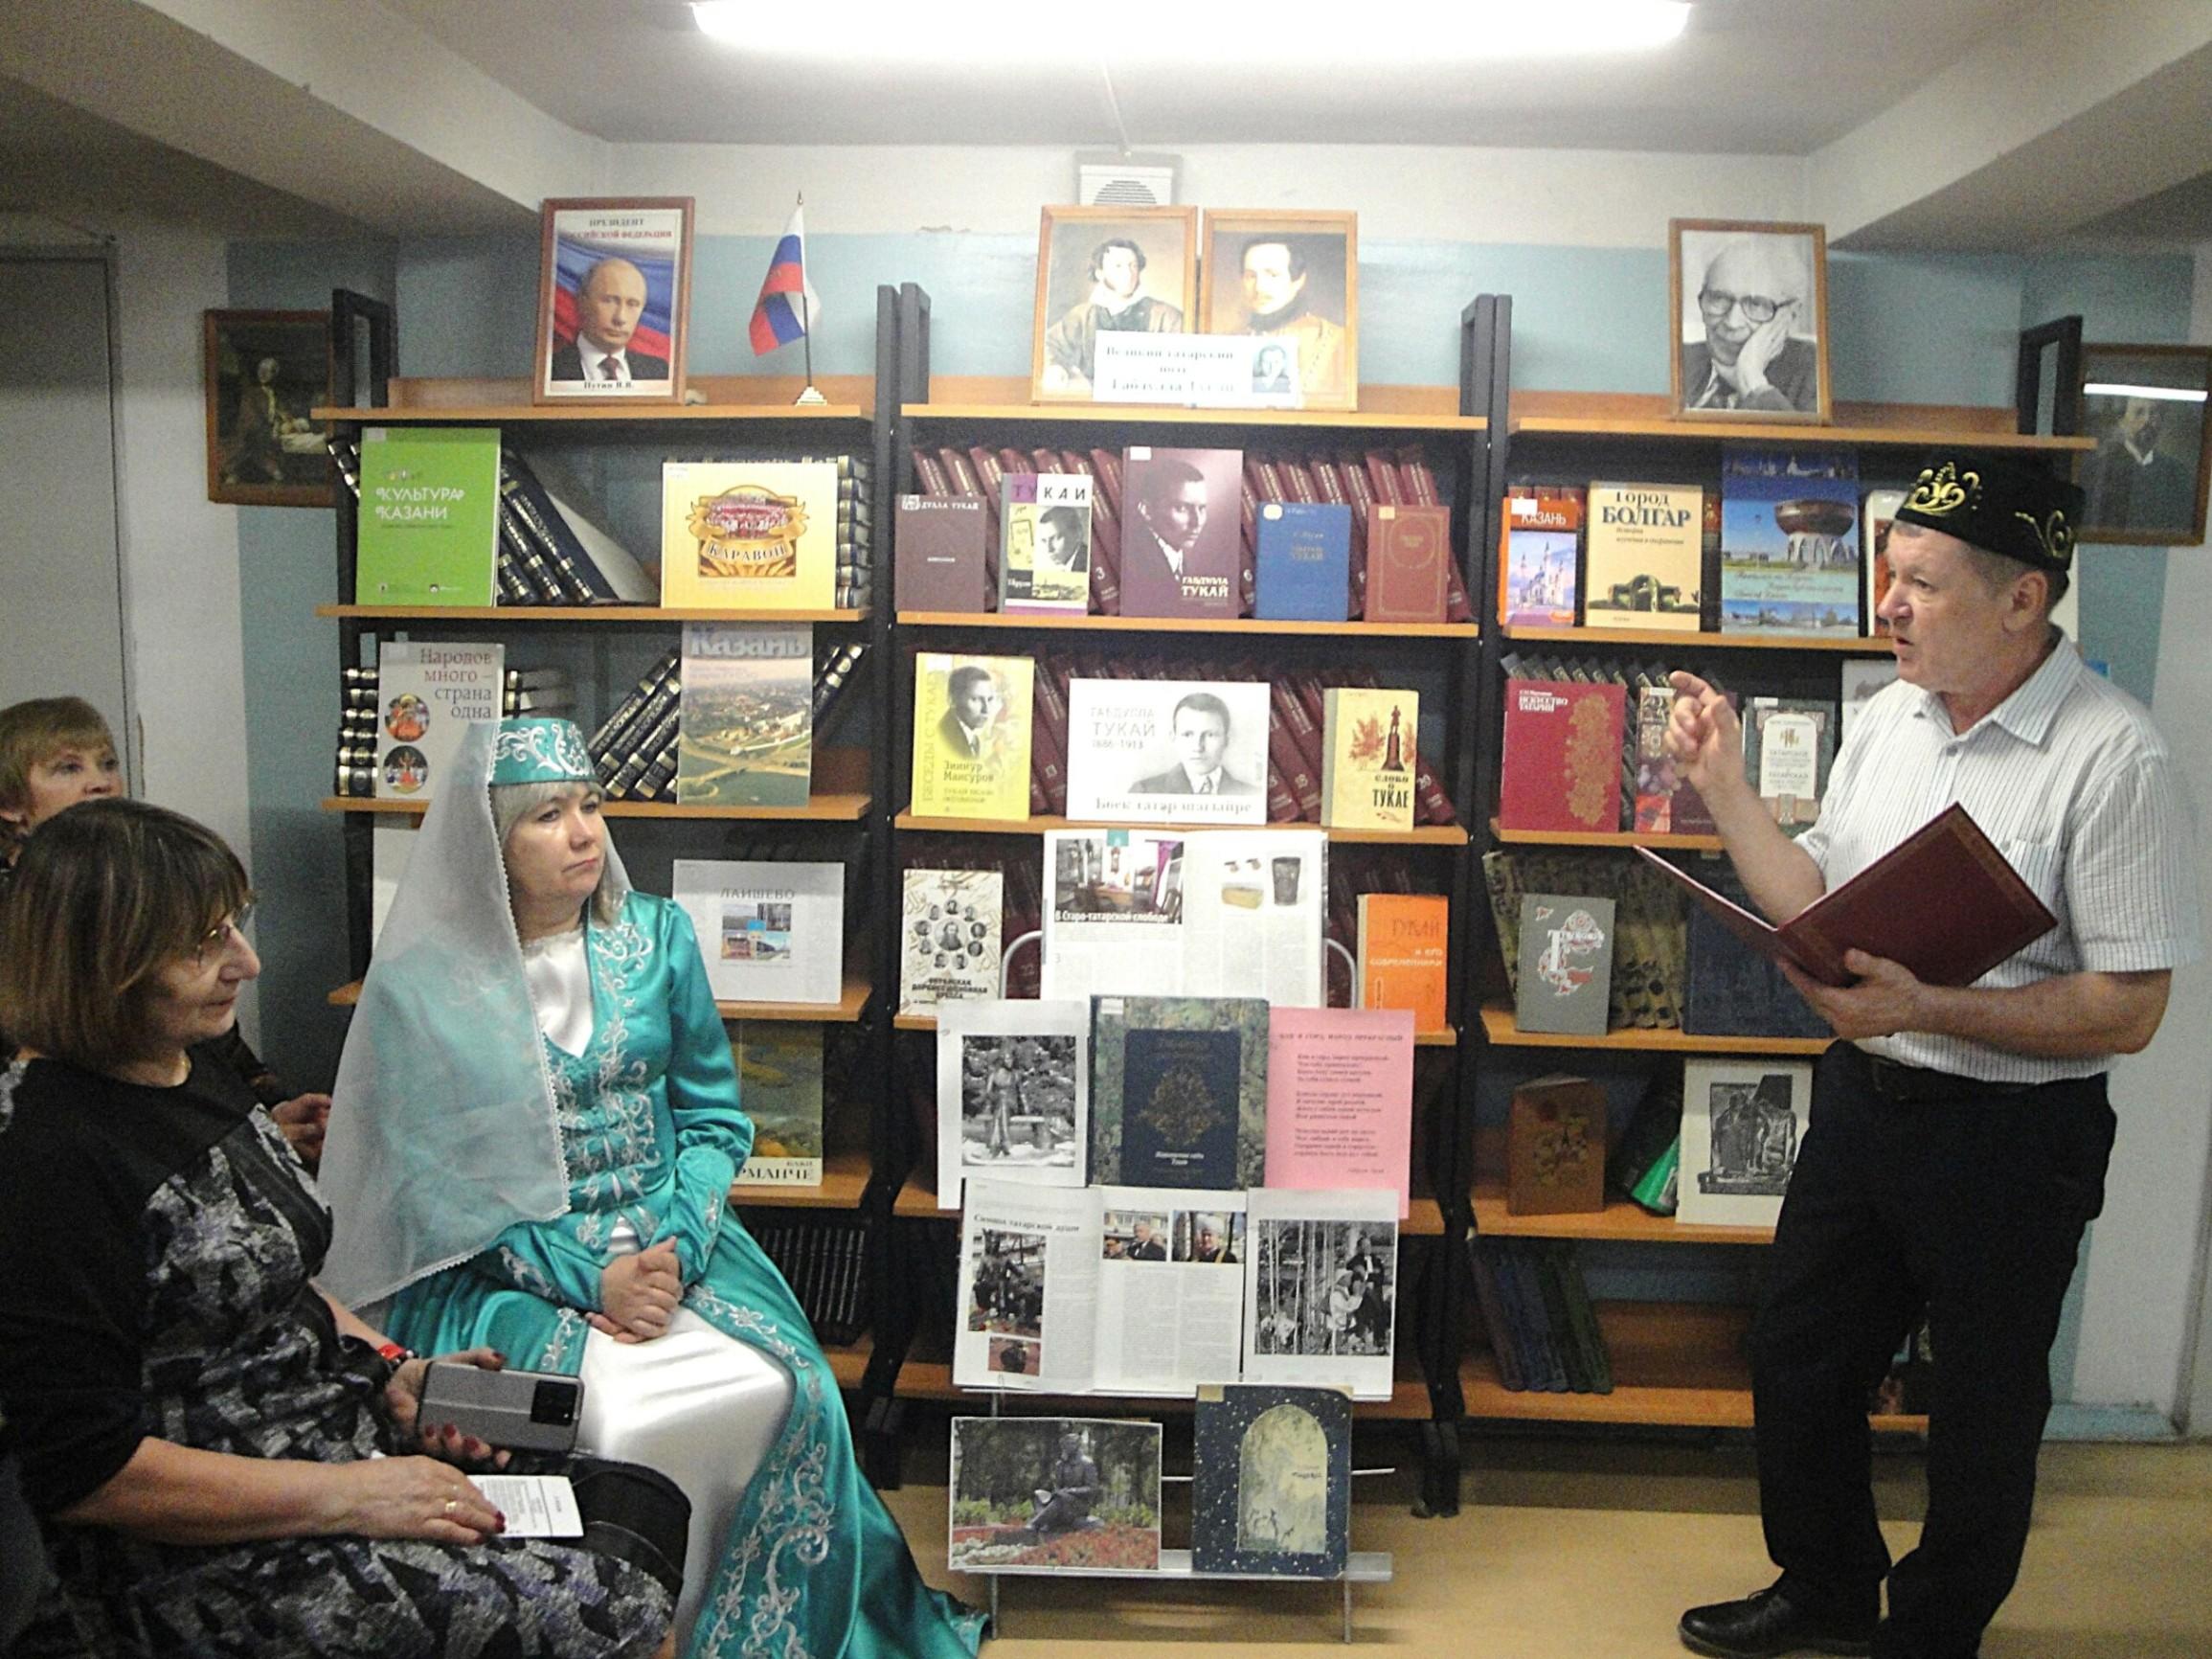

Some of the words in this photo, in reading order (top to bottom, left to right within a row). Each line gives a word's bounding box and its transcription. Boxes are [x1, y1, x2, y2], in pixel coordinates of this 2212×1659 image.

[1521, 511, 1567, 526] КАЗАНЬ
[1602, 506, 1692, 528] БОЛГАР
[1181, 585, 1230, 598] ТУКАЙ
[420, 648, 492, 668] Народов
[424, 670, 478, 682] много
[435, 689, 491, 704] страна
[451, 706, 491, 718] одна
[1372, 789, 1409, 808] ТУКАЕ
